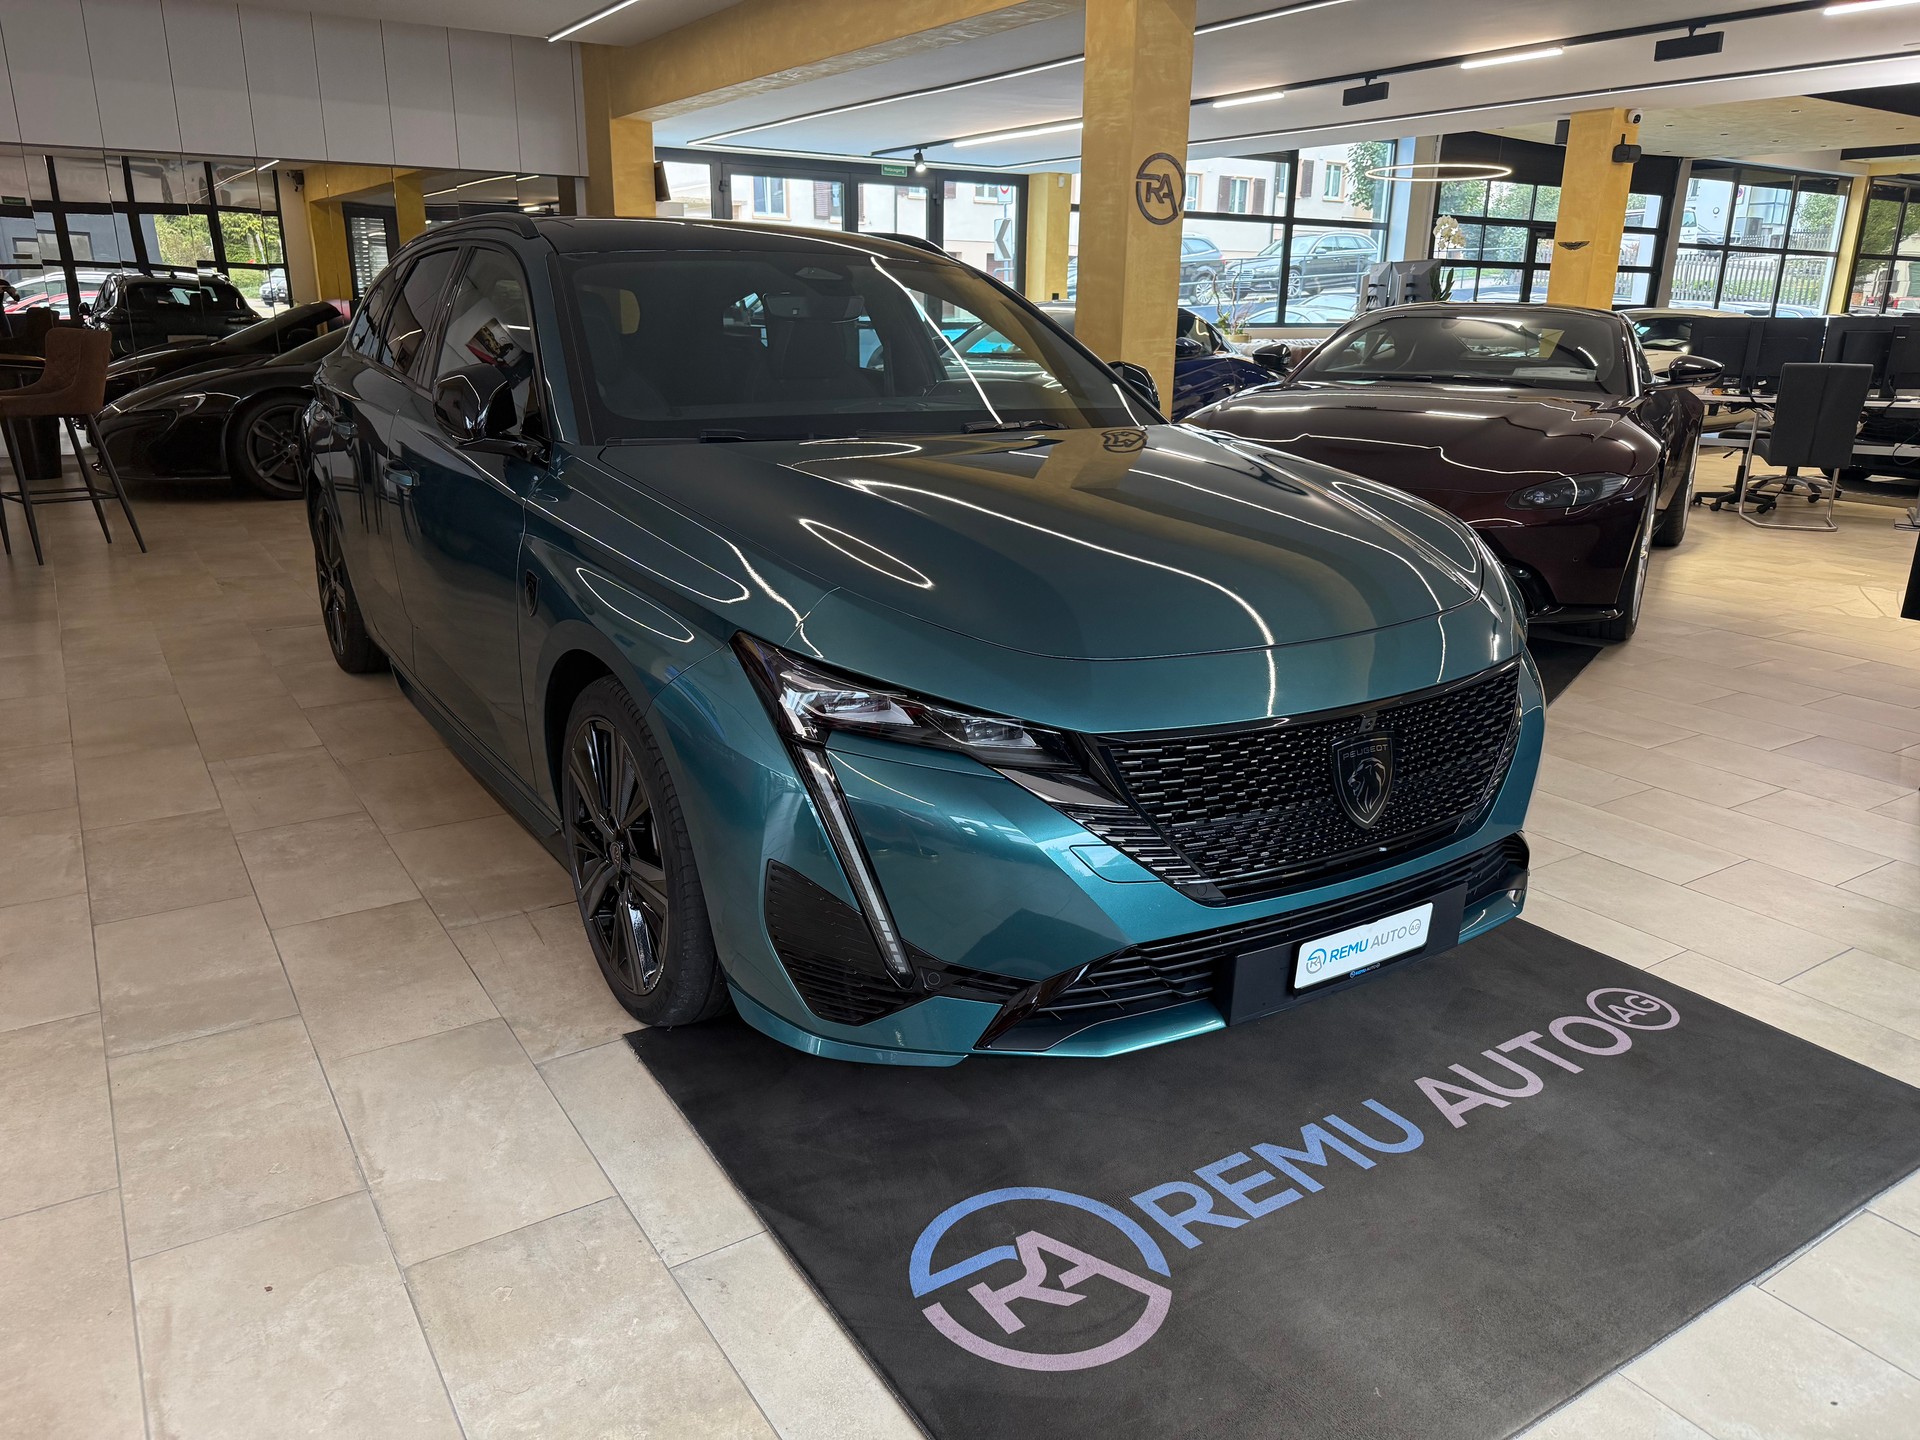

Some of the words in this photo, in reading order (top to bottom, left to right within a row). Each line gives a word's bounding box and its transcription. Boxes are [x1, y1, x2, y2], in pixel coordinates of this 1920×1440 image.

[1342, 744, 1389, 761] PEUGEOT
[1329, 939, 1369, 963] REMU
[1370, 926, 1407, 949] AUTO
[1129, 1098, 1424, 1249] REMU
[1413, 1015, 1633, 1128] AUTO
